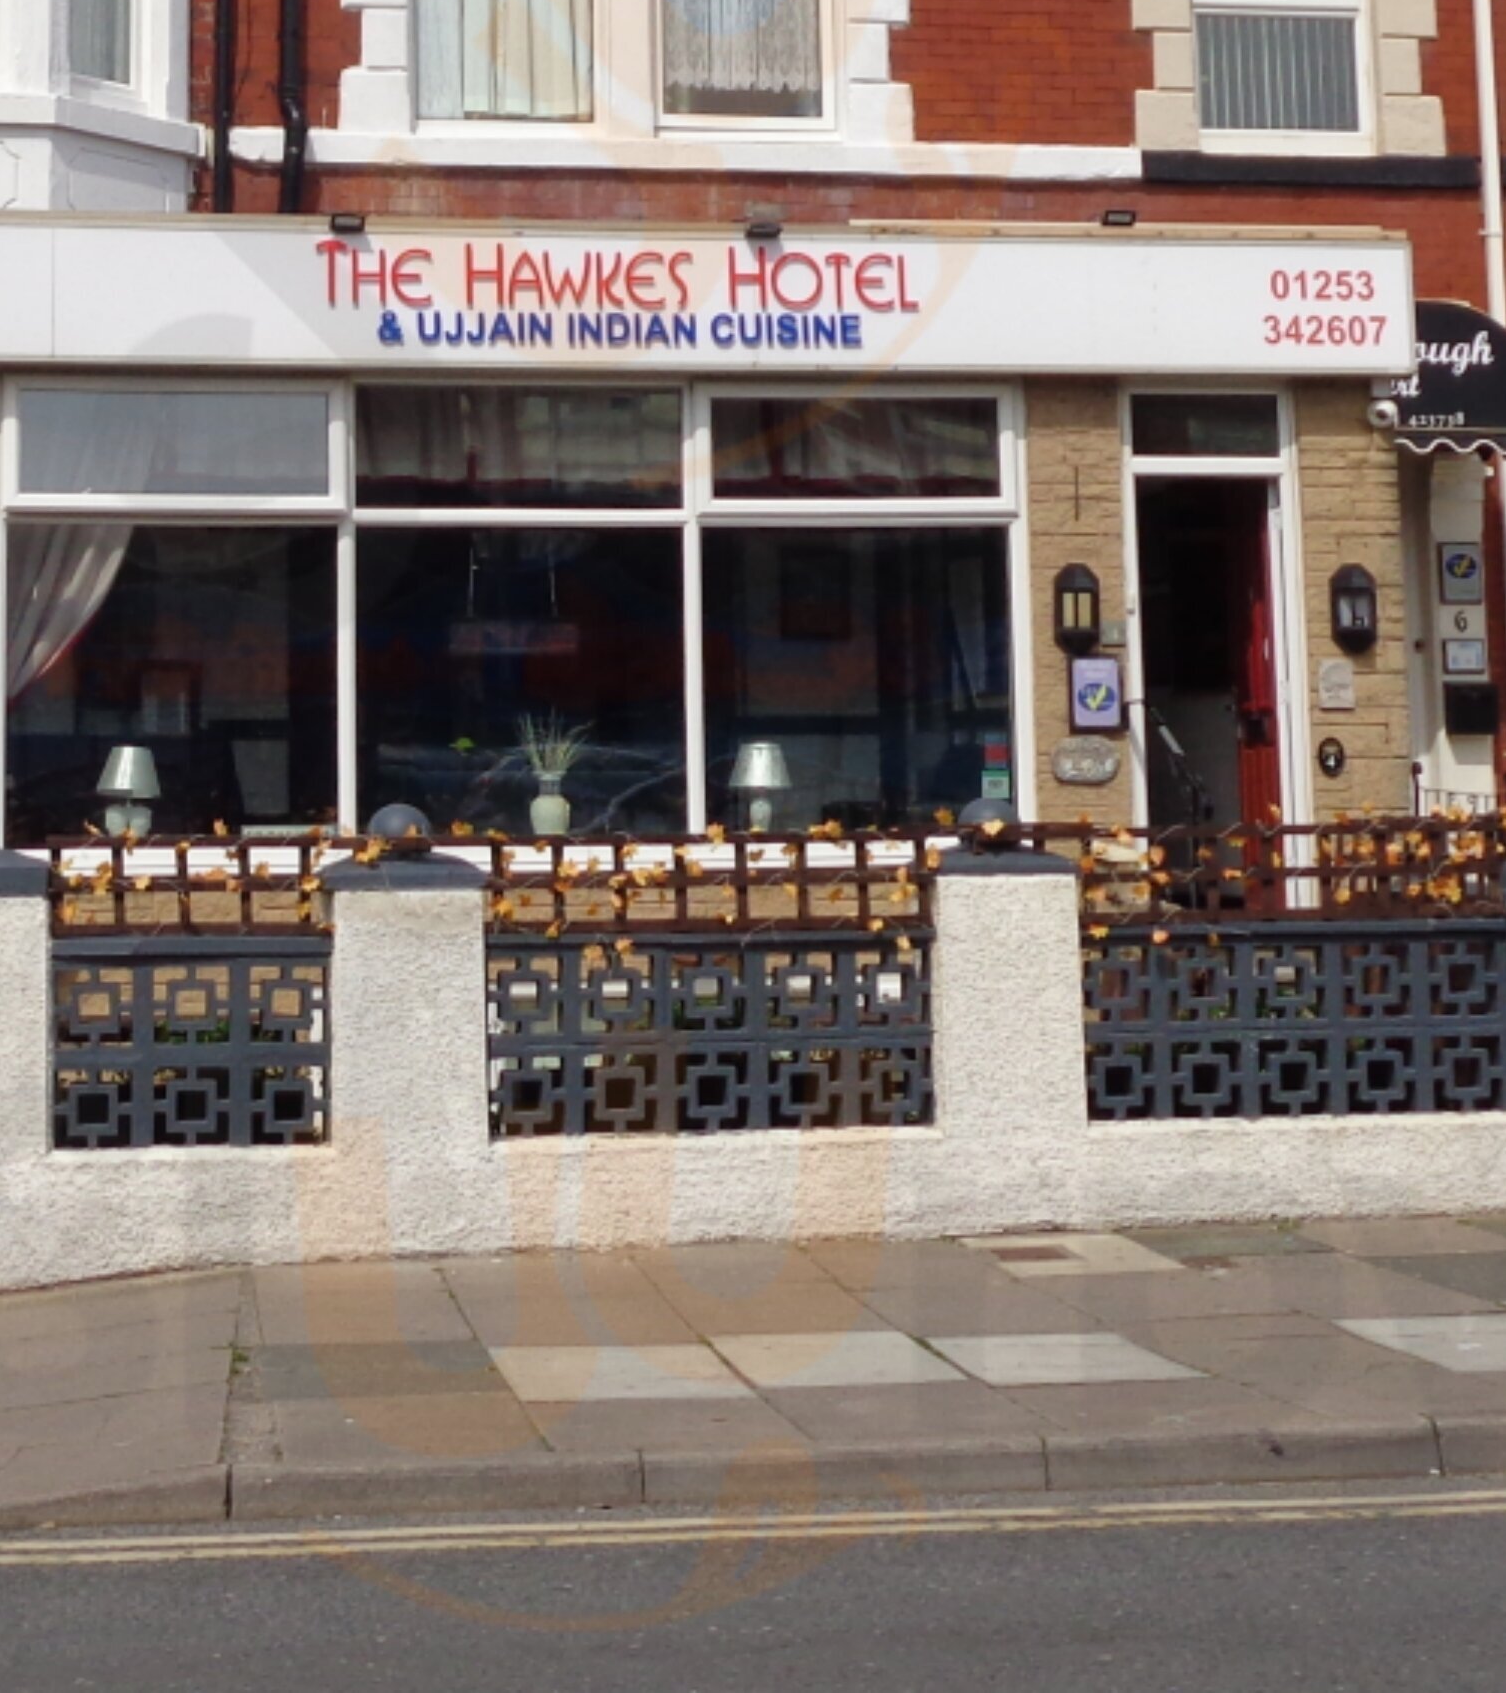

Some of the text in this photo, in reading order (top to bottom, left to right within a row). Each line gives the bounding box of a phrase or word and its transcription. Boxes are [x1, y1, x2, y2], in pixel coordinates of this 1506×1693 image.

[1270, 269, 1375, 302] 01253
[378, 310, 862, 349] & UJJAIN INDIAN CUISINE
[1263, 314, 1388, 347] 342607
[1453, 609, 1468, 633] 6
